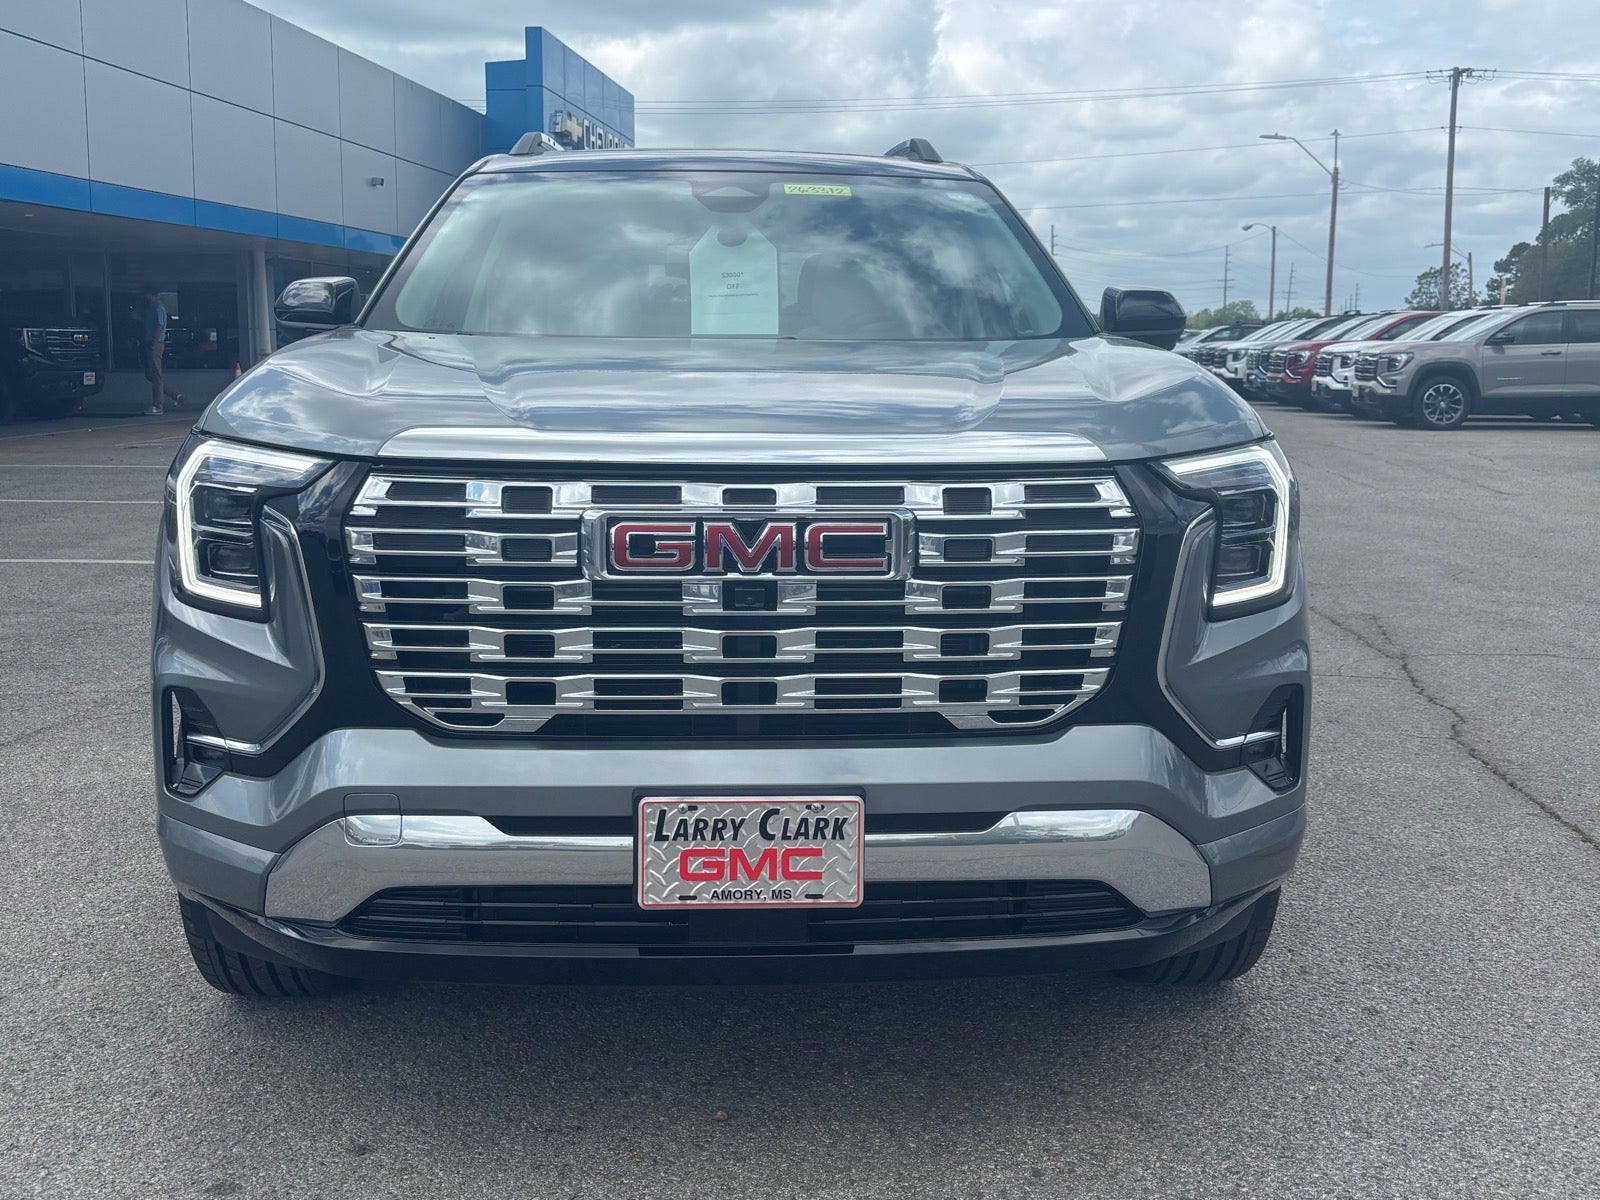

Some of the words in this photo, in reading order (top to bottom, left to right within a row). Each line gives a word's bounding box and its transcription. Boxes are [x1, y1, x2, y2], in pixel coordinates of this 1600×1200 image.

[611, 521, 888, 572] GMC
[653, 808, 746, 842] LARRY
[758, 807, 849, 841] CLARK
[679, 847, 823, 881] GMC
[710, 889, 767, 901] AMORY,
[771, 889, 792, 900] MS
